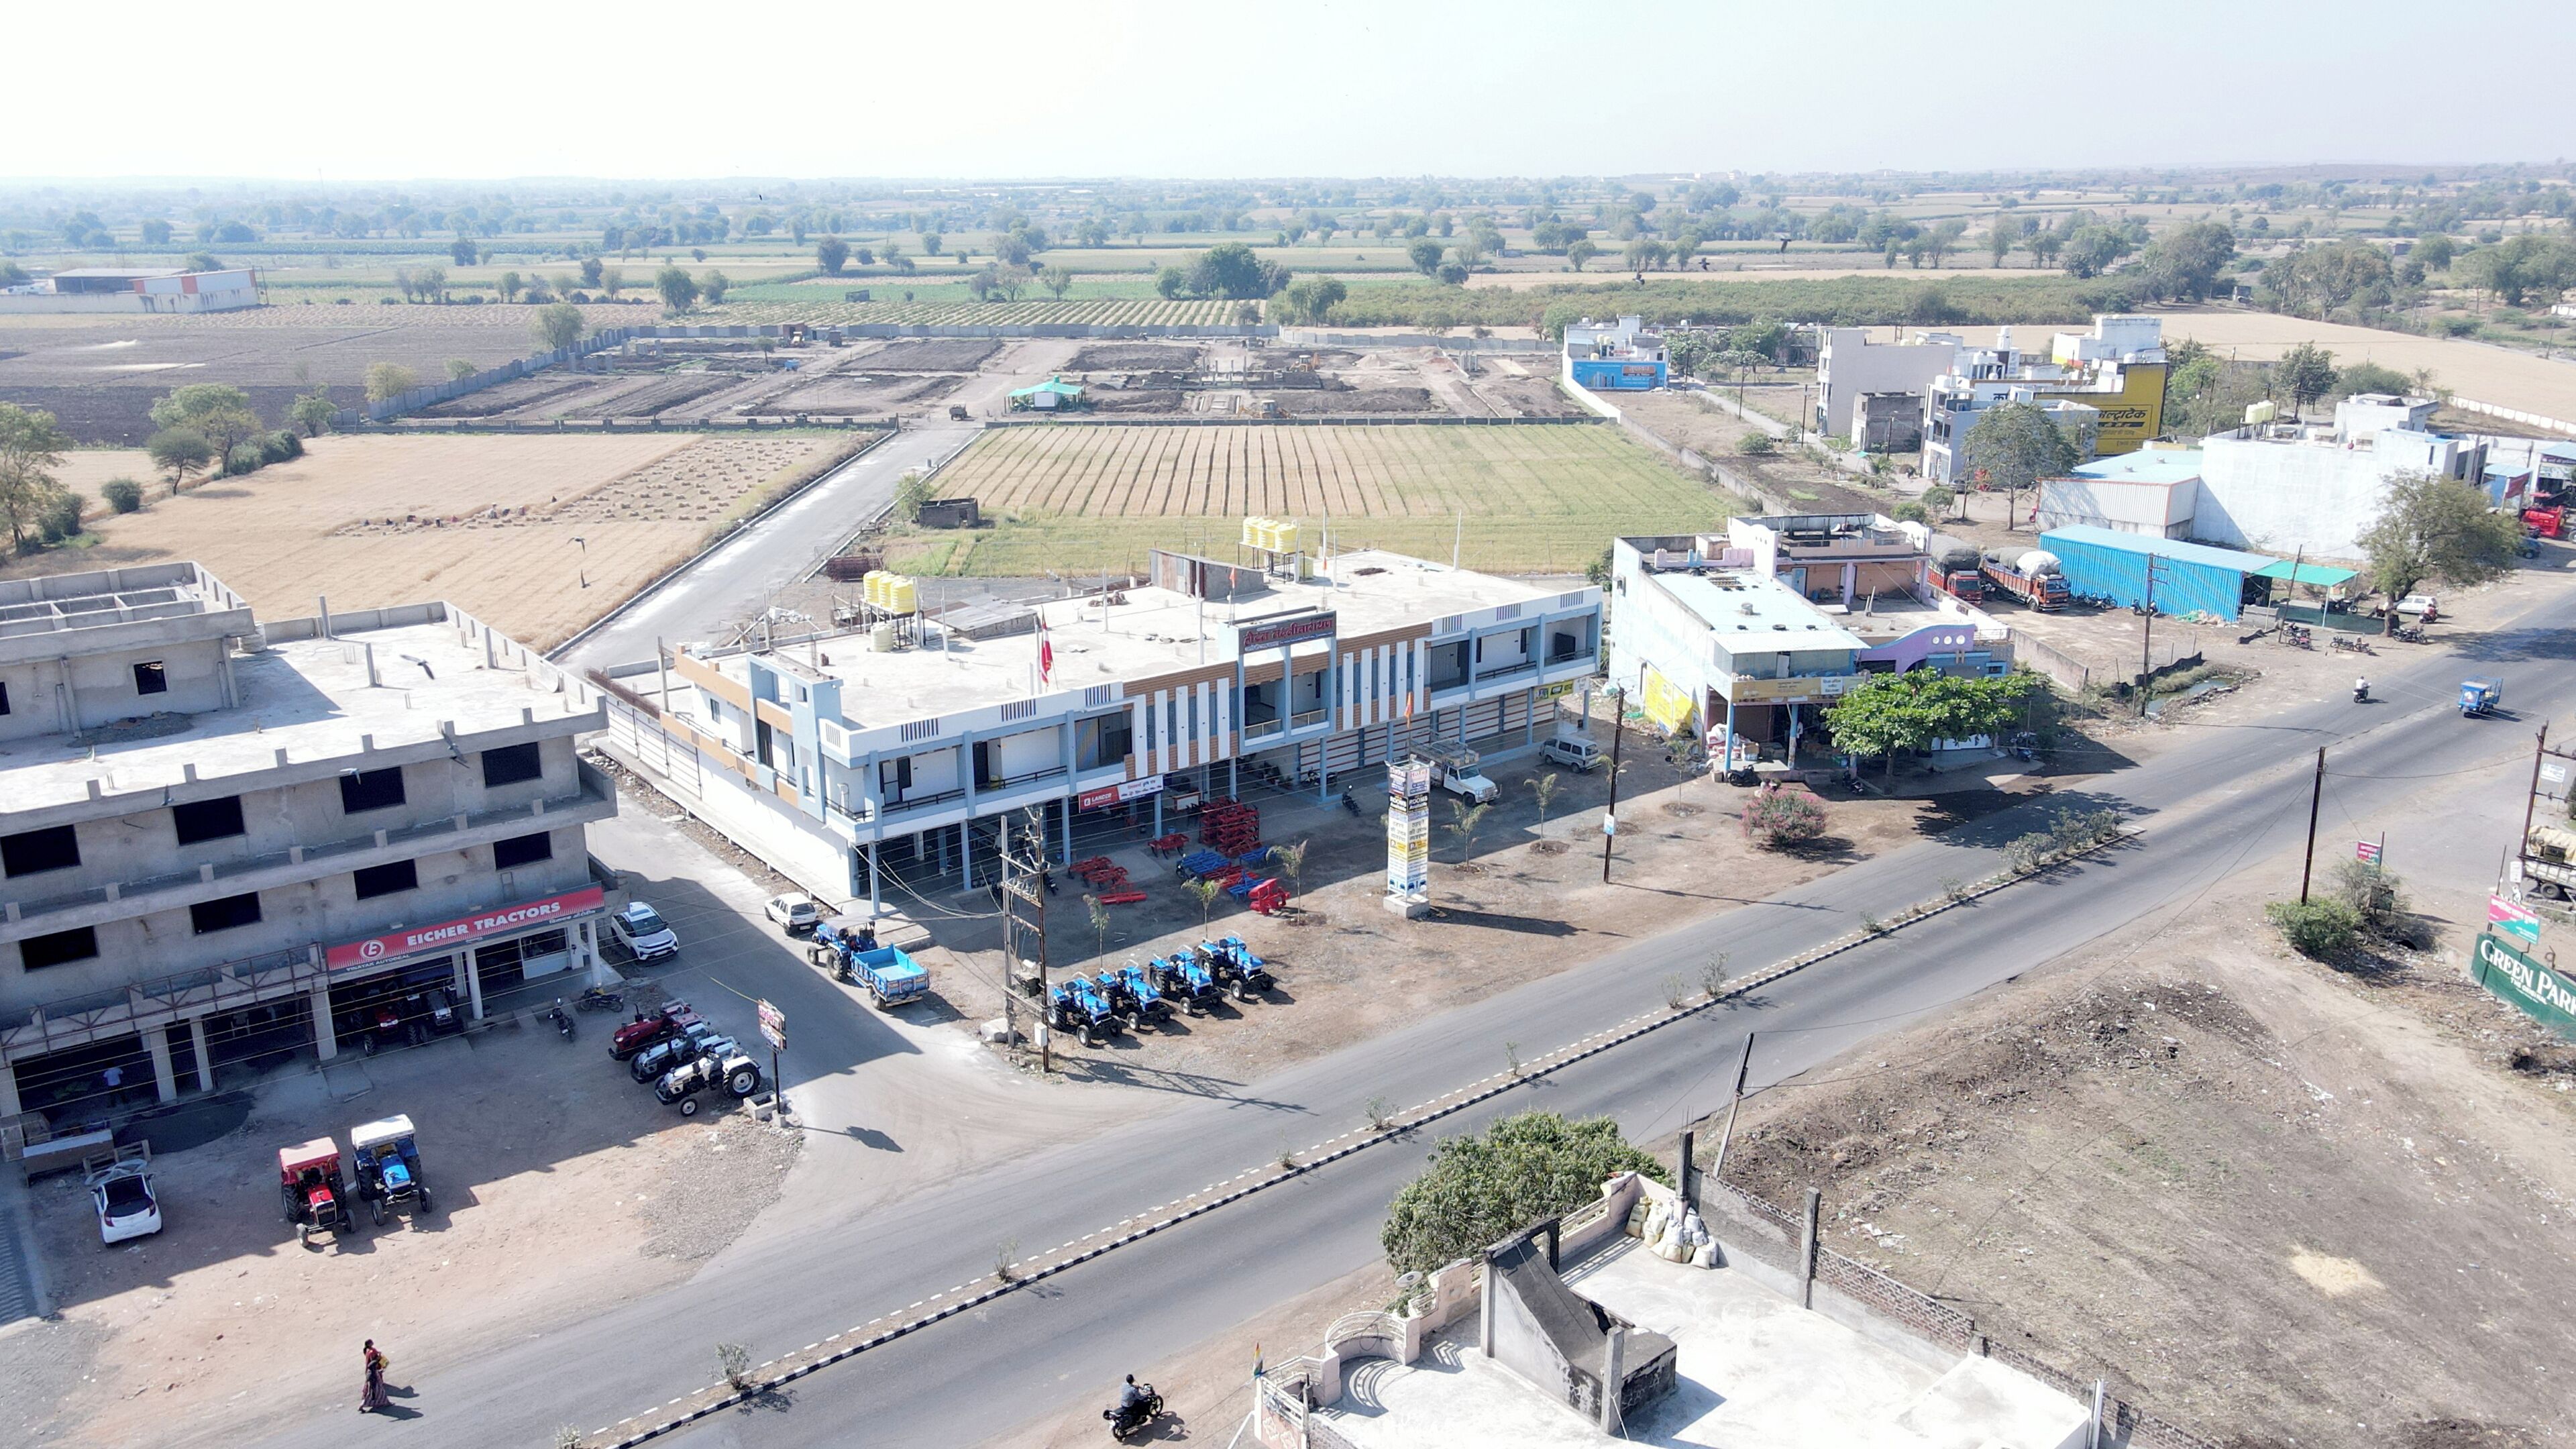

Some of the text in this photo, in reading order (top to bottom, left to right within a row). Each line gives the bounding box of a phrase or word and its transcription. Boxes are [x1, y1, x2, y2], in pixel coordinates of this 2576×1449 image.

[407, 924, 470, 947] EICHER
[474, 902, 561, 930] TRACTORS
[345, 954, 411, 972] VINAYAK AUTODEAL
[2481, 939, 2534, 989] GREEN
